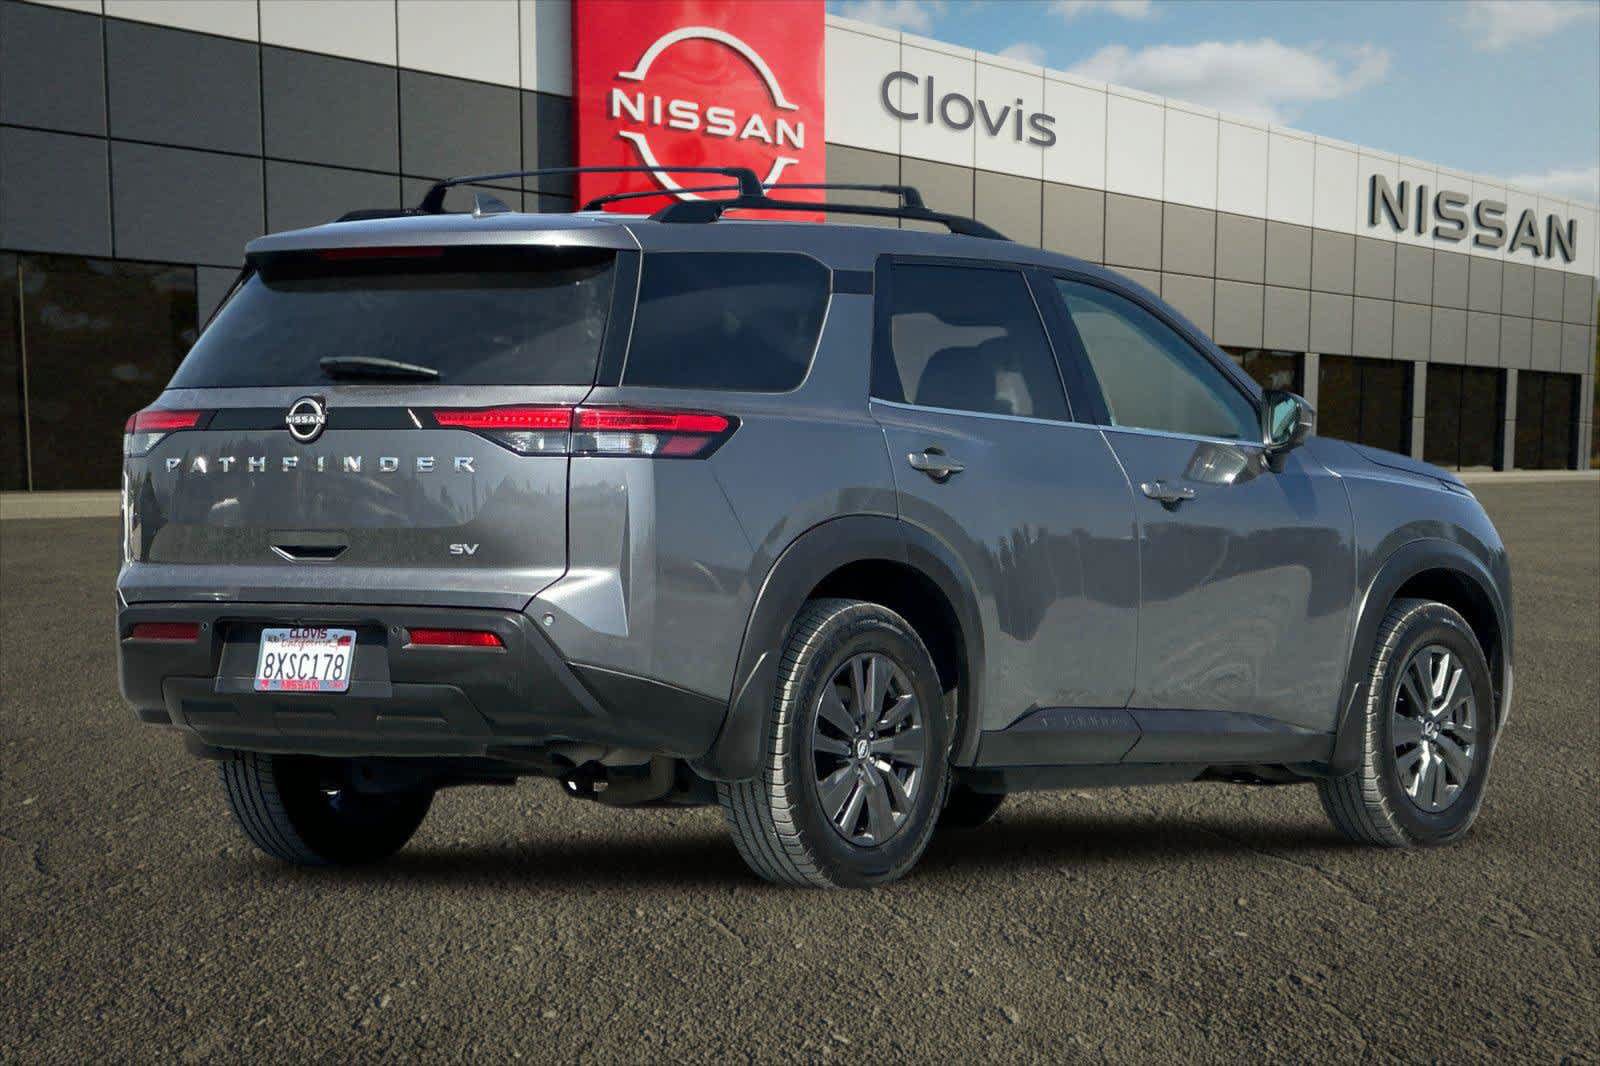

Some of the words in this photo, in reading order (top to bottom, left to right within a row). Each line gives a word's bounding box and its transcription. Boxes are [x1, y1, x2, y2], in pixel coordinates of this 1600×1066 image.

[611, 87, 805, 150] NISSAN
[880, 70, 1057, 147] Clovis
[1368, 173, 1578, 263] NISSAN
[285, 414, 326, 425] NISSAN
[165, 456, 476, 473] PATHFINDER
[449, 543, 480, 556] SV
[289, 628, 328, 639] CLOVIS
[263, 652, 345, 680] 8XSC178
